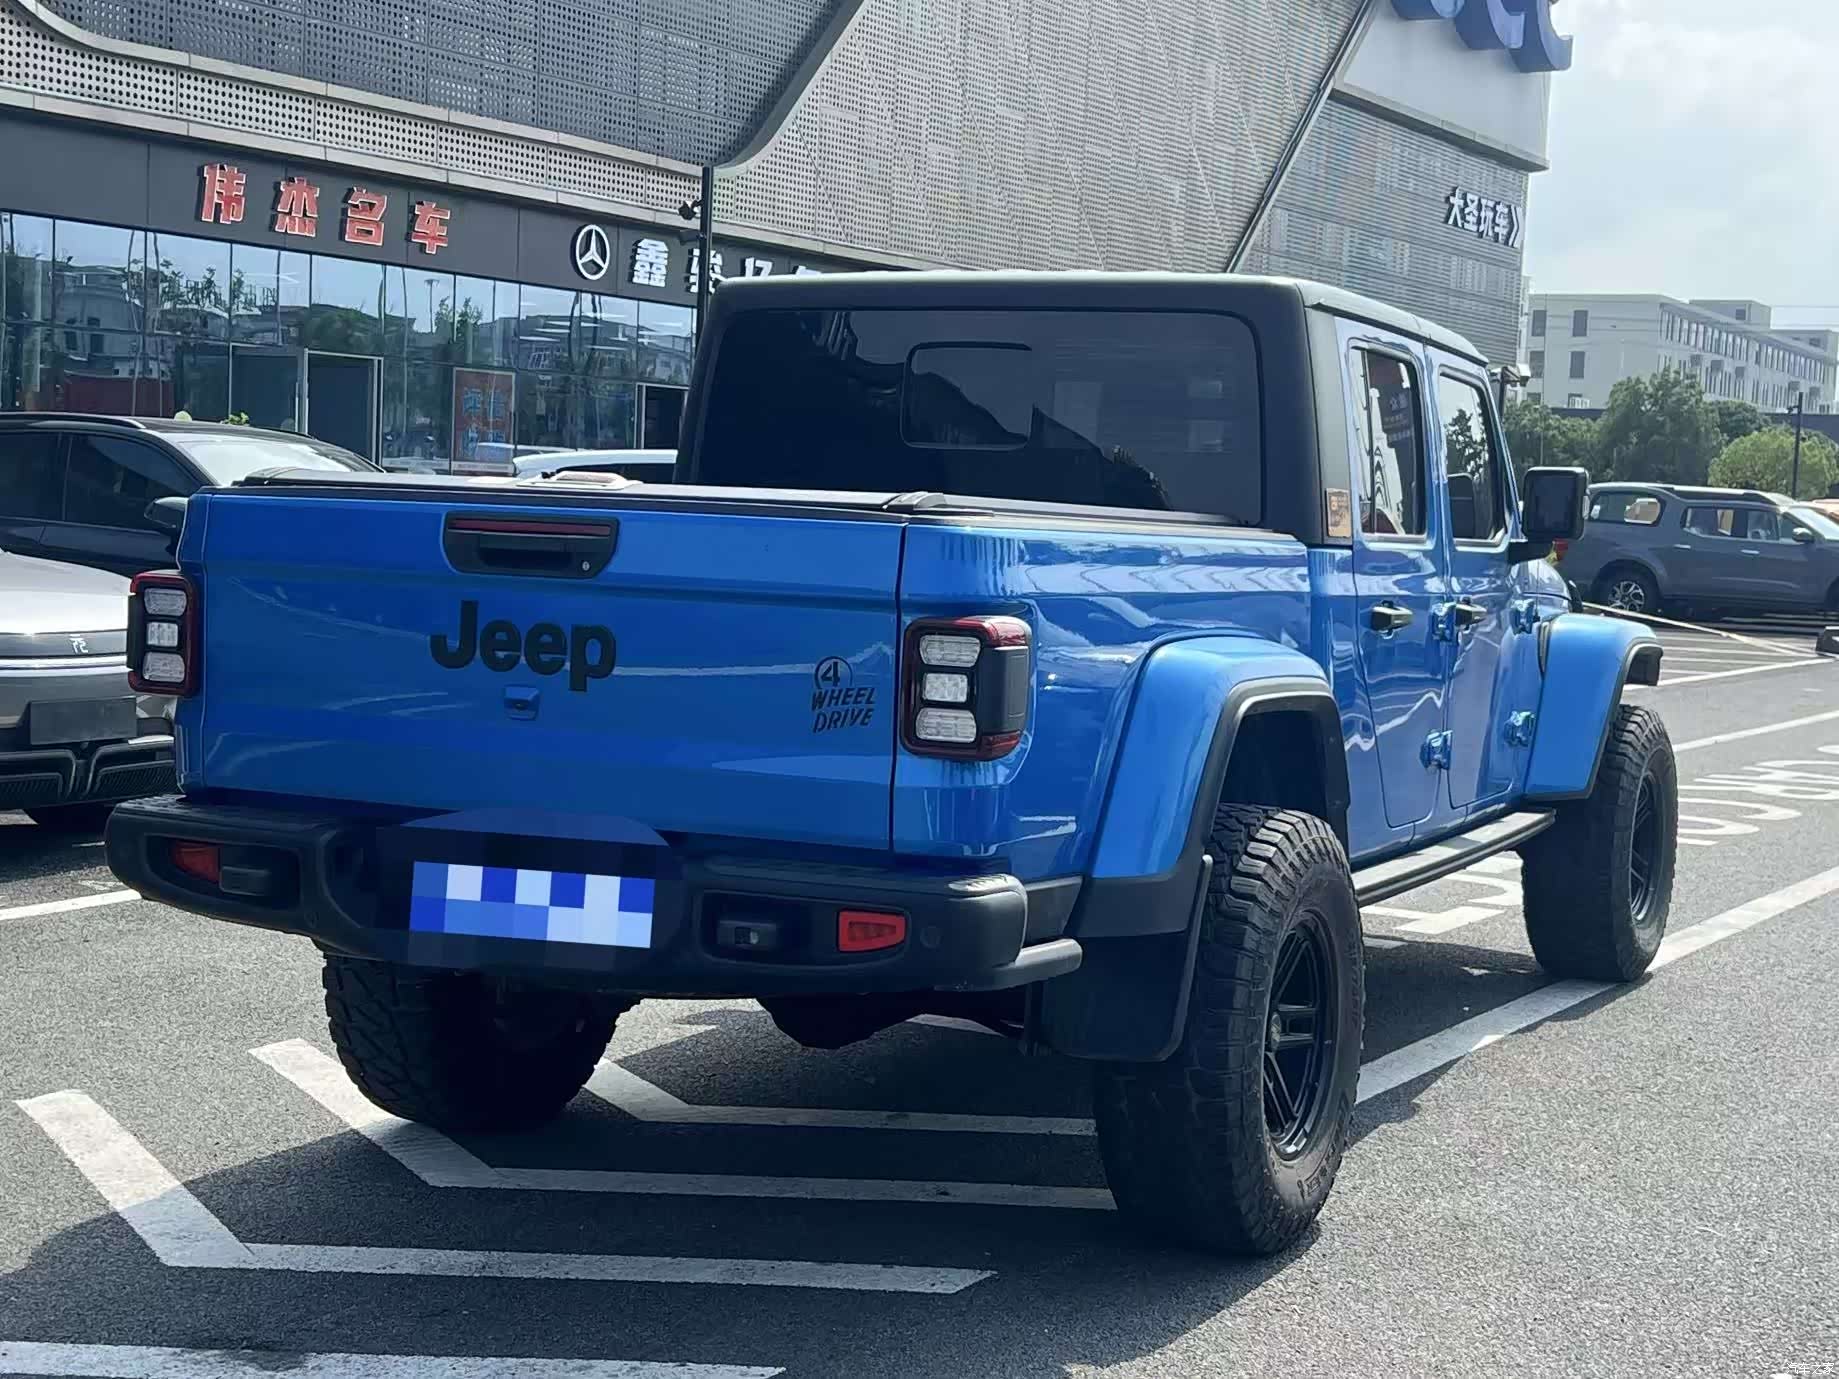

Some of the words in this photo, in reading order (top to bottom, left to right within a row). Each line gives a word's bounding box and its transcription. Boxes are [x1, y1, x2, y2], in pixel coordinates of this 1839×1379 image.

[201, 164, 451, 255] 伟杰名车
[430, 599, 617, 692] Jeep
[811, 687, 876, 711] WHEEL
[812, 708, 875, 733] DRIVE
